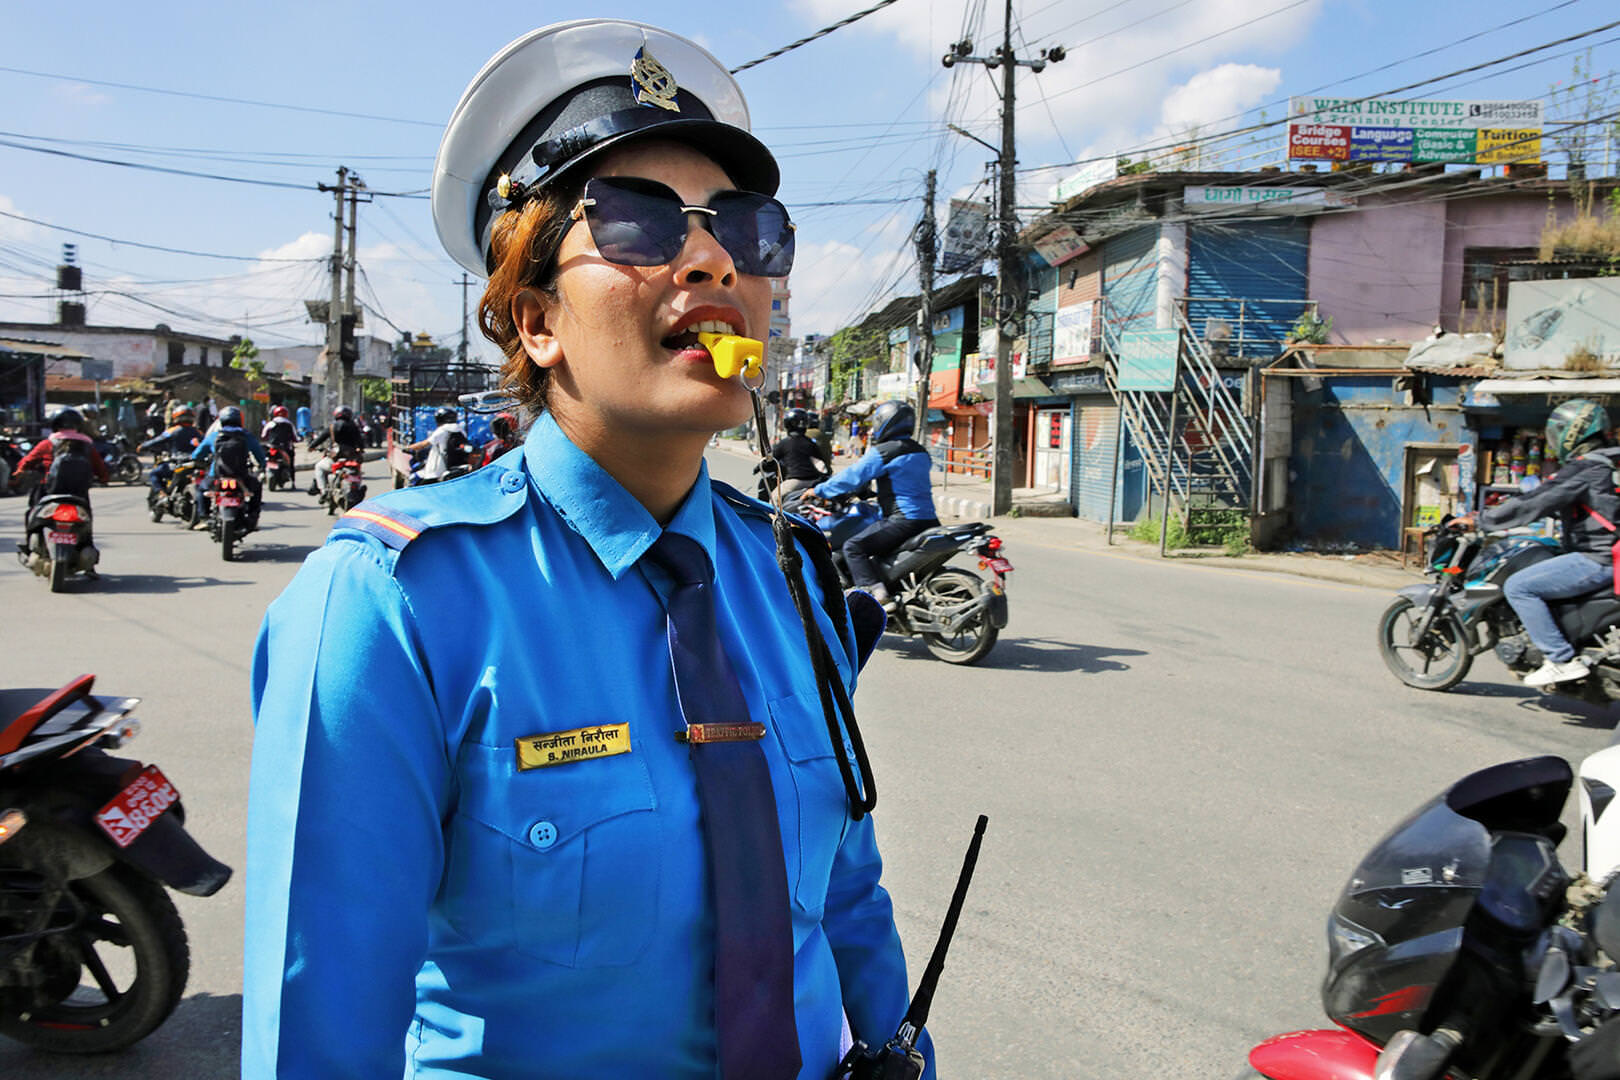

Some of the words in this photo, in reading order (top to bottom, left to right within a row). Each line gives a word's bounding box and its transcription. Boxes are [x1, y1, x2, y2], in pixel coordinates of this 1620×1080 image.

[1367, 100, 1465, 117] INSTITUTE
[1328, 114, 1400, 127] Training
[1410, 115, 1465, 126] Center
[1297, 125, 1342, 138] Bridge
[1351, 127, 1413, 143] Language
[1415, 129, 1476, 140] Computer
[1480, 129, 1539, 140] Tuition
[1291, 135, 1347, 146] Courses
[1417, 139, 1454, 151] (Basic
[1455, 140, 1466, 149] &
[532, 734, 577, 752] सन्जीता
[580, 727, 620, 744] निरौला
[547, 751, 560, 762] S.
[561, 743, 609, 761] NIRAULA
